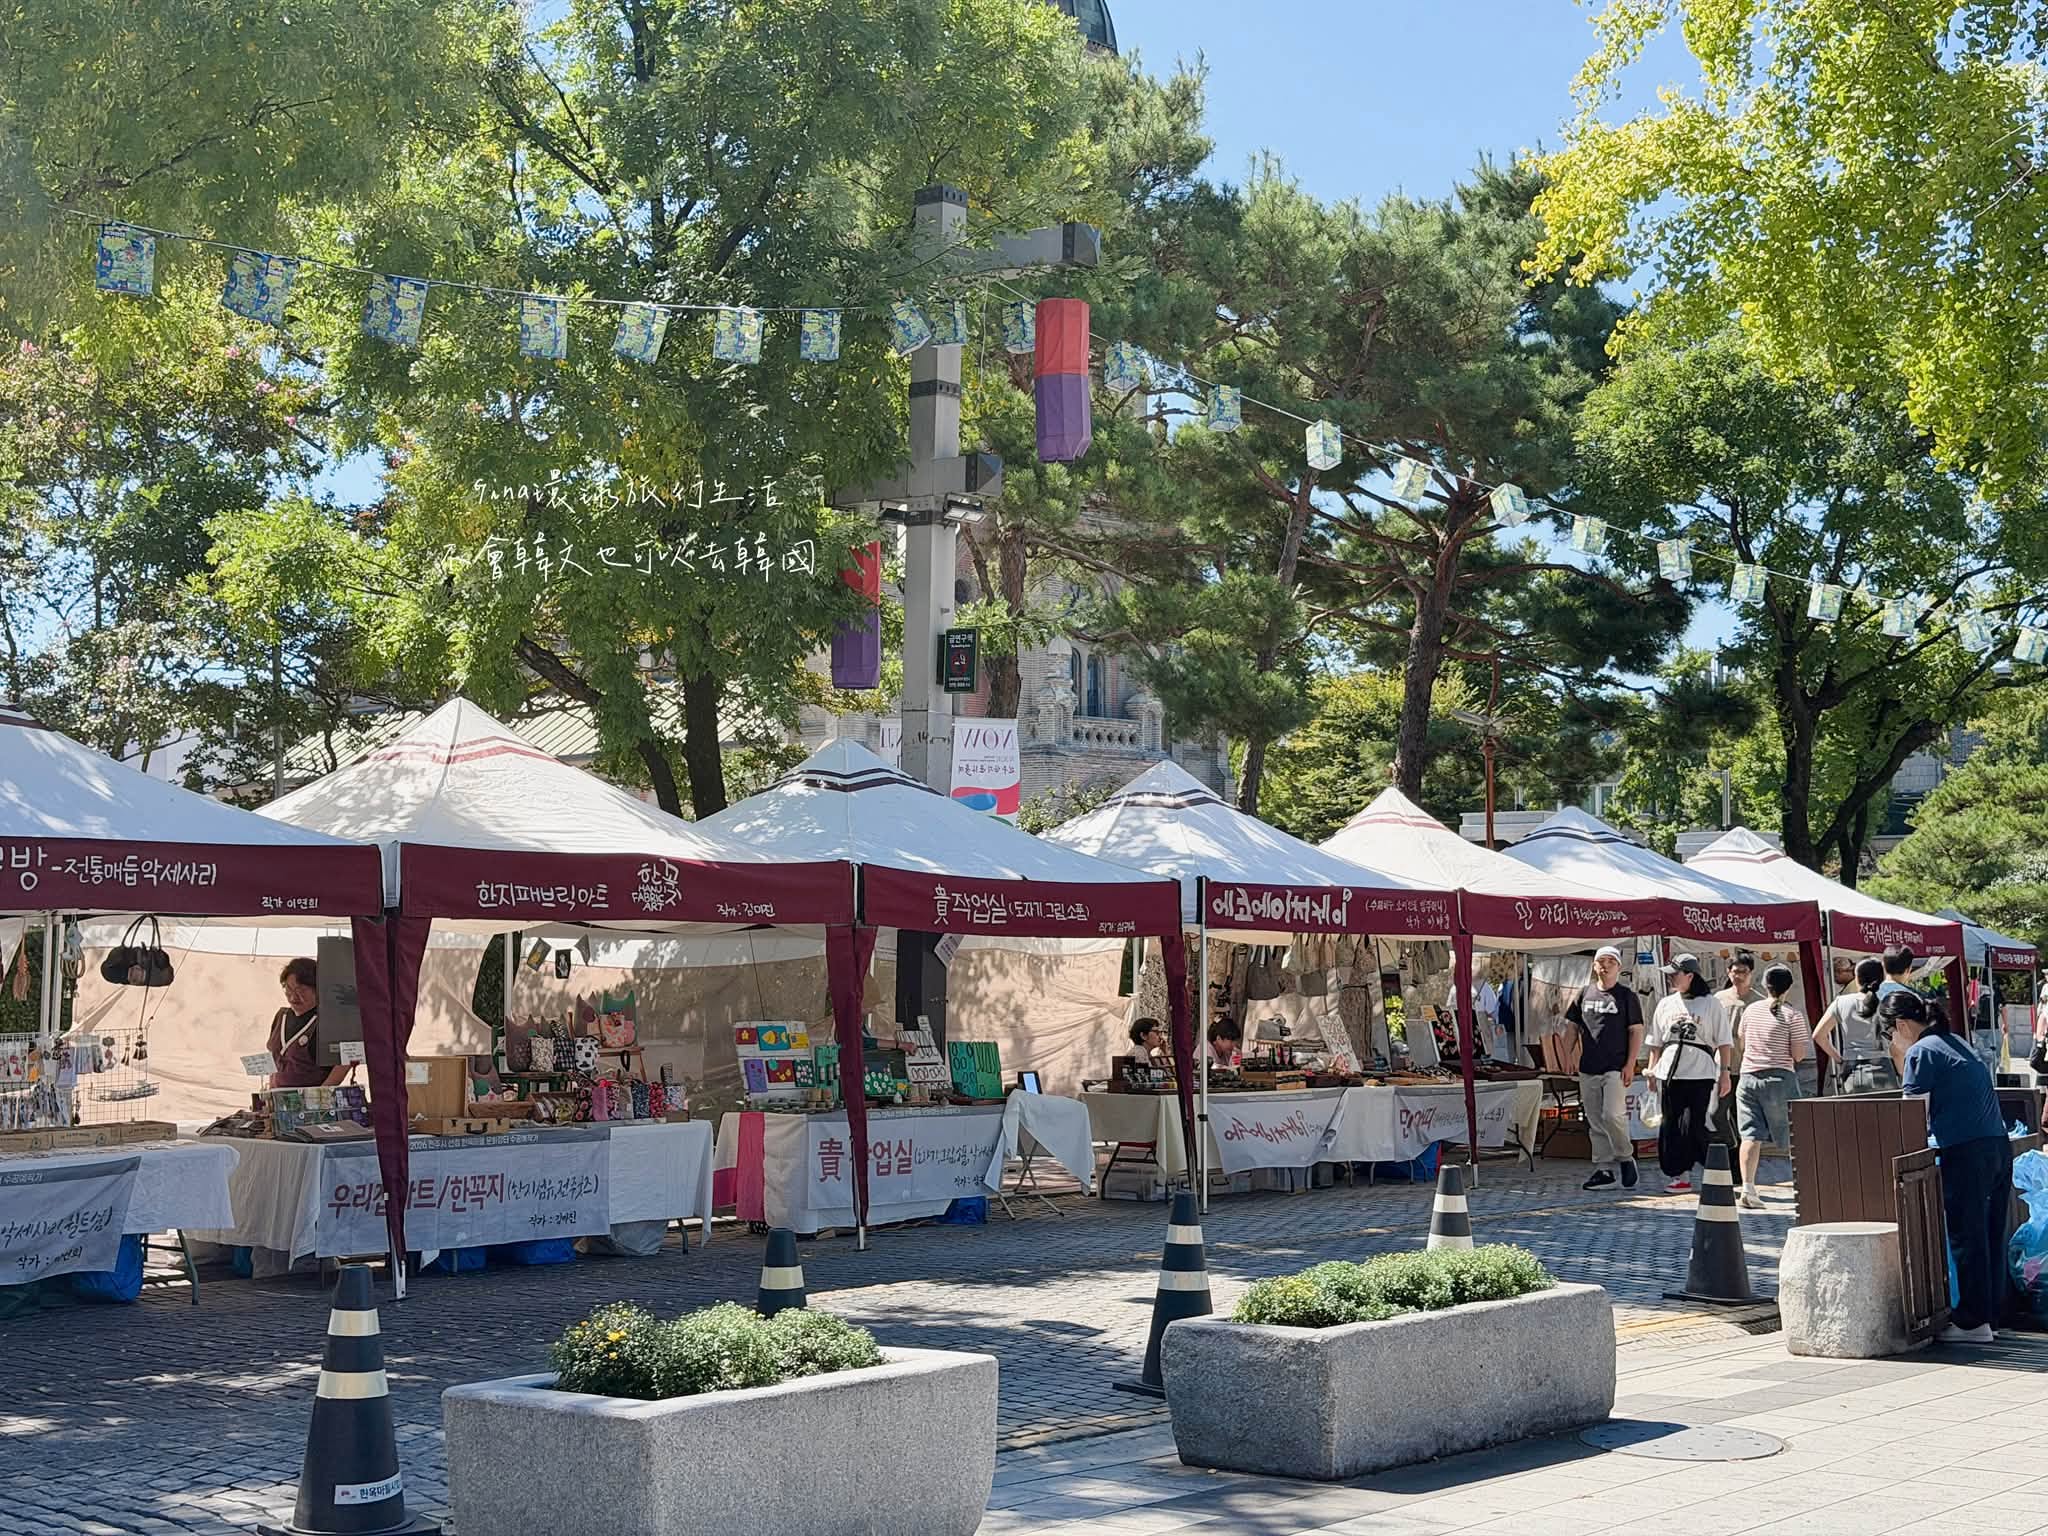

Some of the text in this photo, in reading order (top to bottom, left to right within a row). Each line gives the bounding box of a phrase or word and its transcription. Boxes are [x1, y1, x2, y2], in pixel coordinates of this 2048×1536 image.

[638, 884, 667, 893] HANJI
[476, 879, 609, 911] 한지패브릭아트
[631, 892, 665, 903] FABRIC
[642, 902, 665, 912] ART
[1583, 1000, 1618, 1014] FILA
